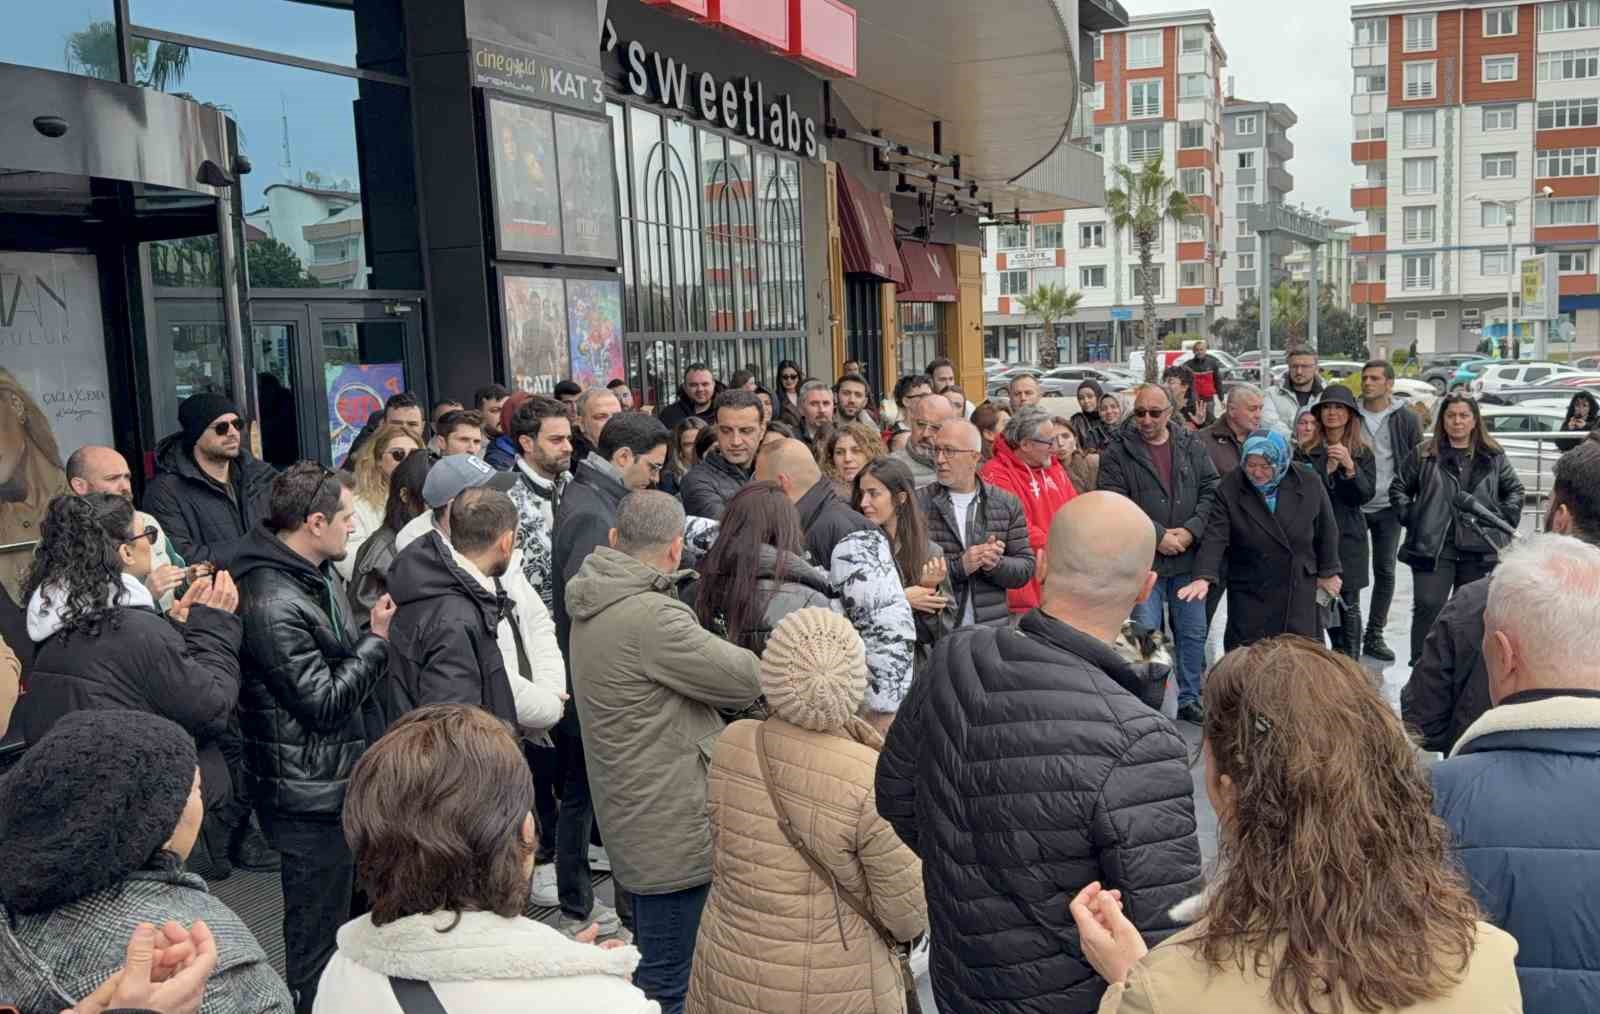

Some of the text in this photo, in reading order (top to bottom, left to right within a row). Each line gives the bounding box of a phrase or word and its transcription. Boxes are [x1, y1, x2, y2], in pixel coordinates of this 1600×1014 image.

[549, 68, 605, 103] KAT 3
[628, 40, 818, 158] sweetlabs
